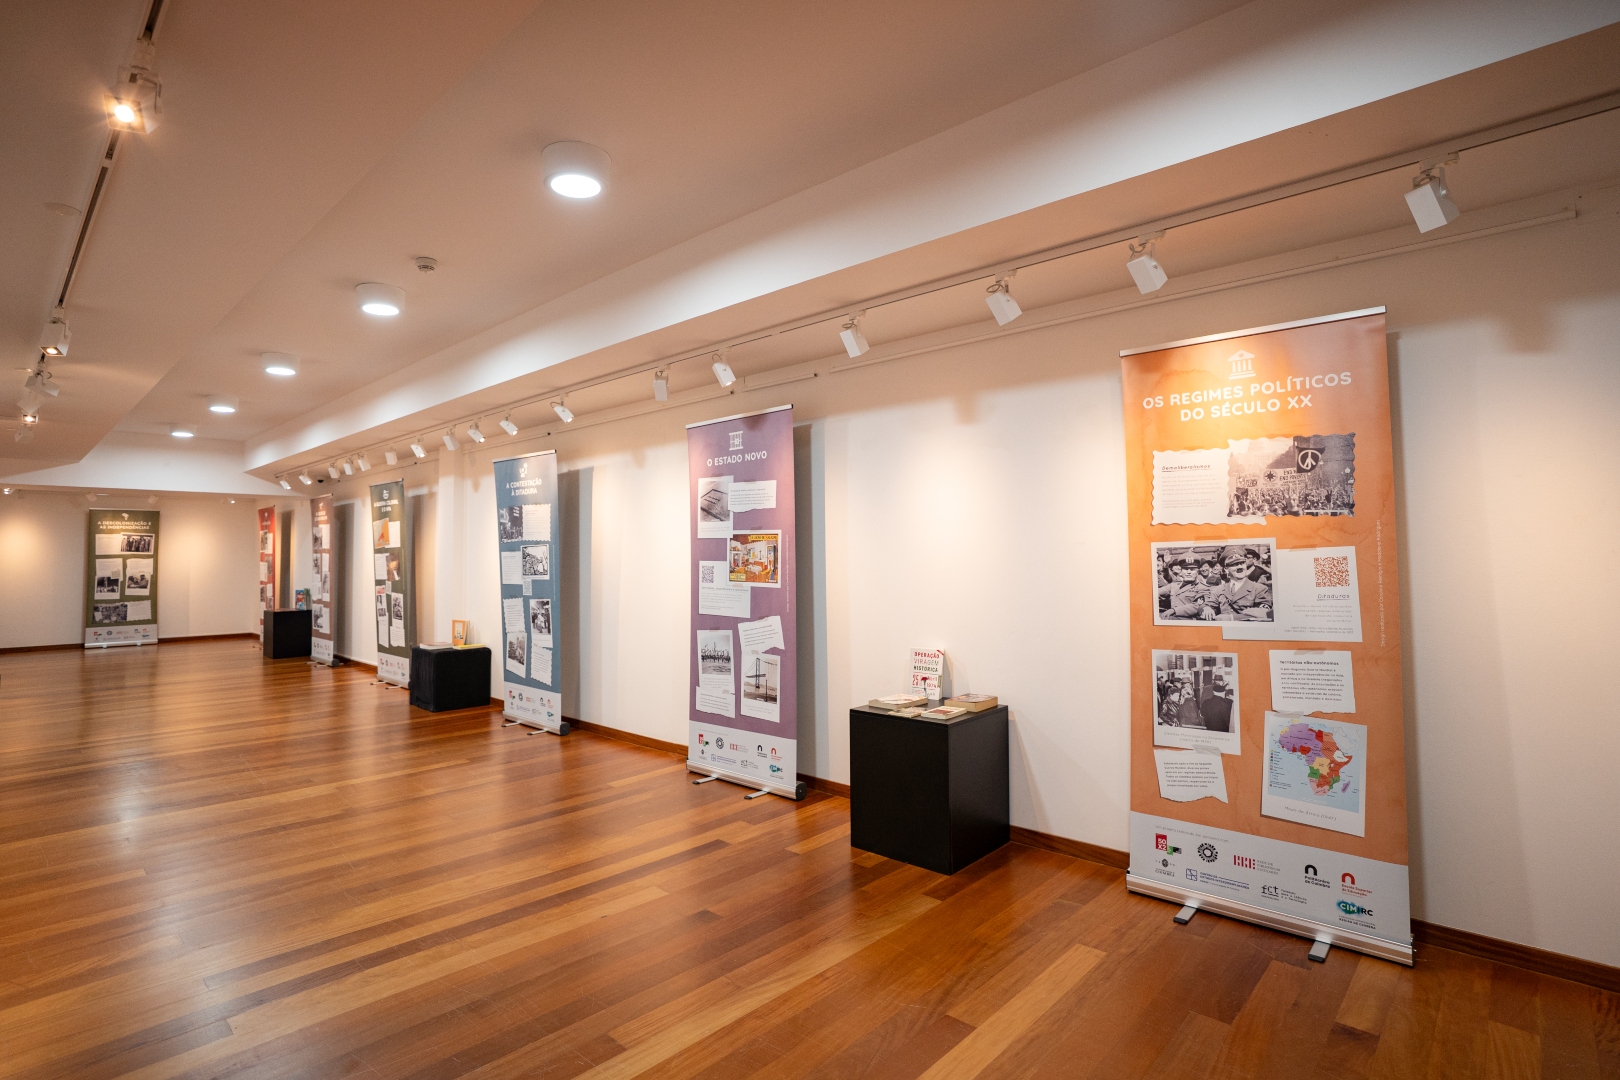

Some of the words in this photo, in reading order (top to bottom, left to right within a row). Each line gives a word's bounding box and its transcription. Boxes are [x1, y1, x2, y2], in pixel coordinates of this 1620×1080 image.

[1143, 396, 1164, 409] OS
[1169, 385, 1244, 406] REGIMES
[1250, 372, 1352, 396] POLÍTICOS
[1180, 407, 1204, 421] DO
[1210, 399, 1281, 418] SÉCULO
[1287, 394, 1313, 410] XX
[715, 454, 742, 465] ESTADO
[745, 451, 767, 461] NOVO
[510, 478, 542, 488] CONTESTAÇÃO
[516, 488, 538, 496] DITADURA
